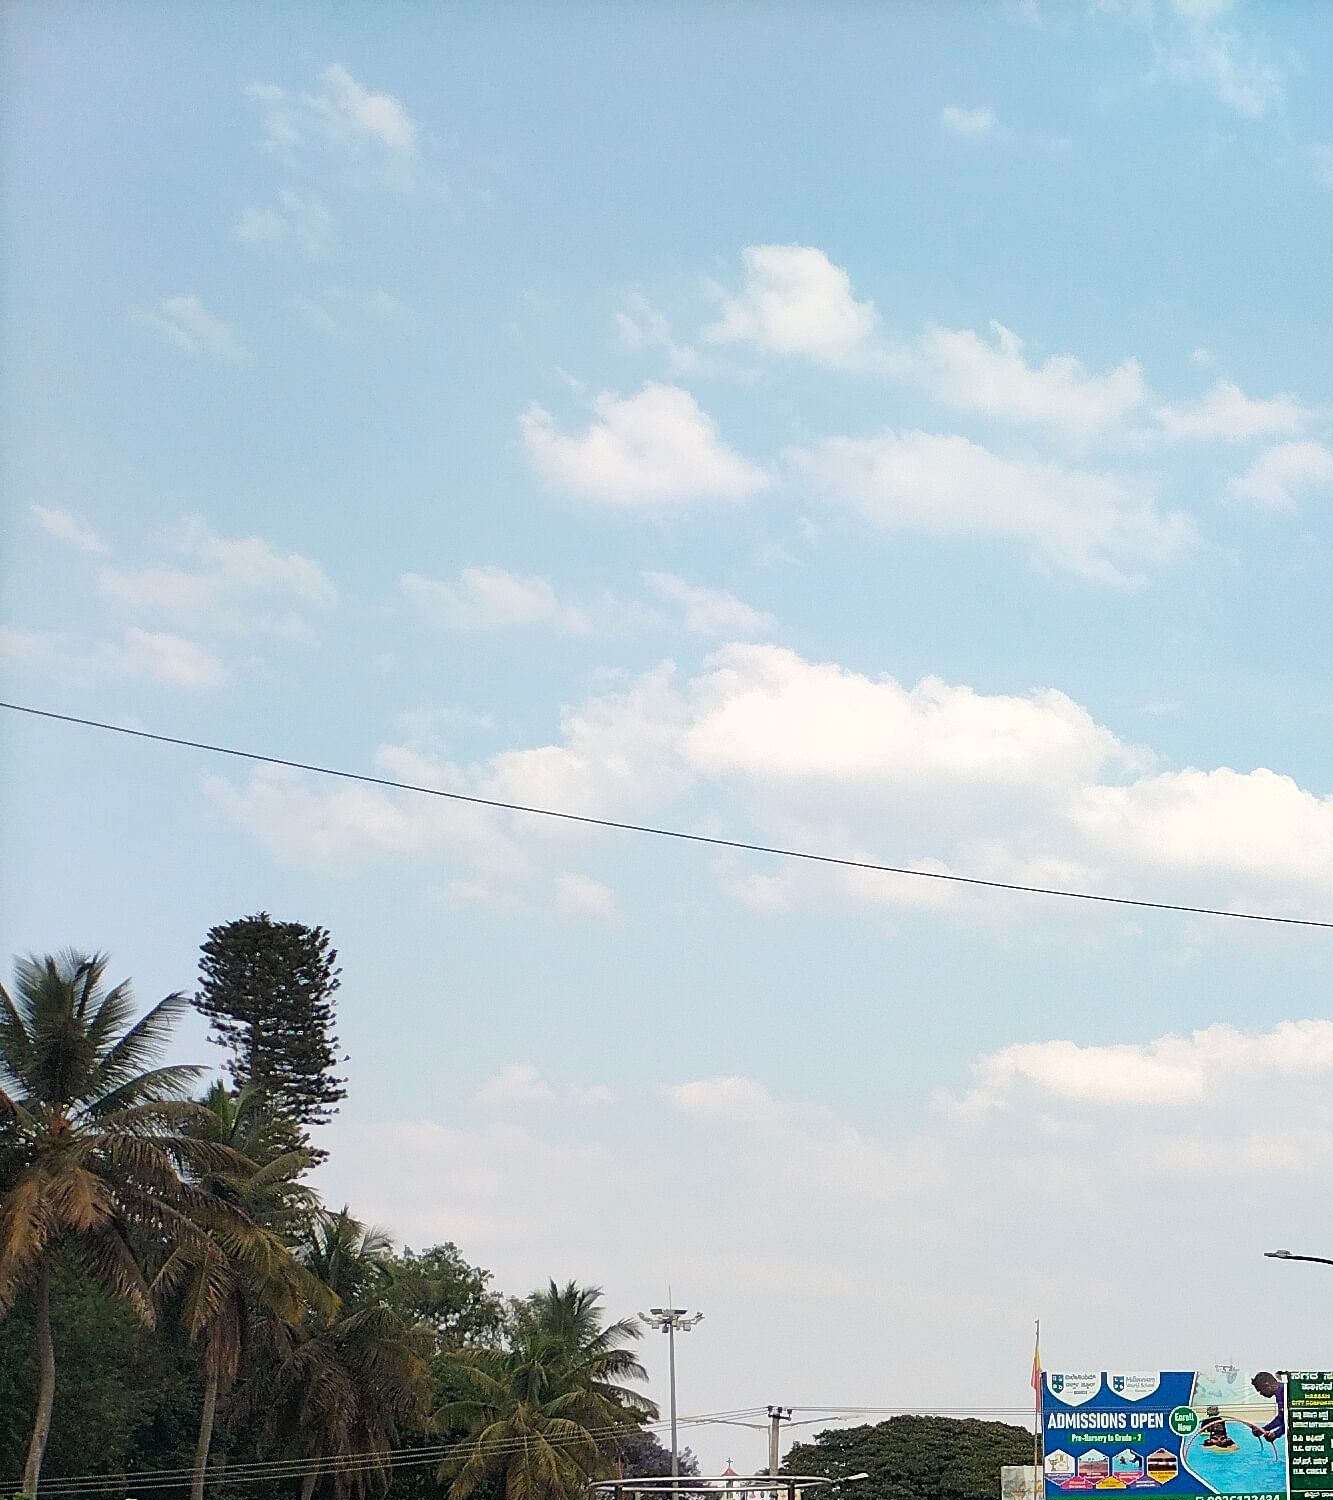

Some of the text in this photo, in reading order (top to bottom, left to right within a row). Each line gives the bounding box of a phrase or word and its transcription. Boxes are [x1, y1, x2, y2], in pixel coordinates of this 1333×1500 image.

[1048, 1412, 1164, 1429] ADMISSIONS OPEN
[1174, 1413, 1194, 1422] Enroll
[1178, 1423, 1192, 1432] Now
